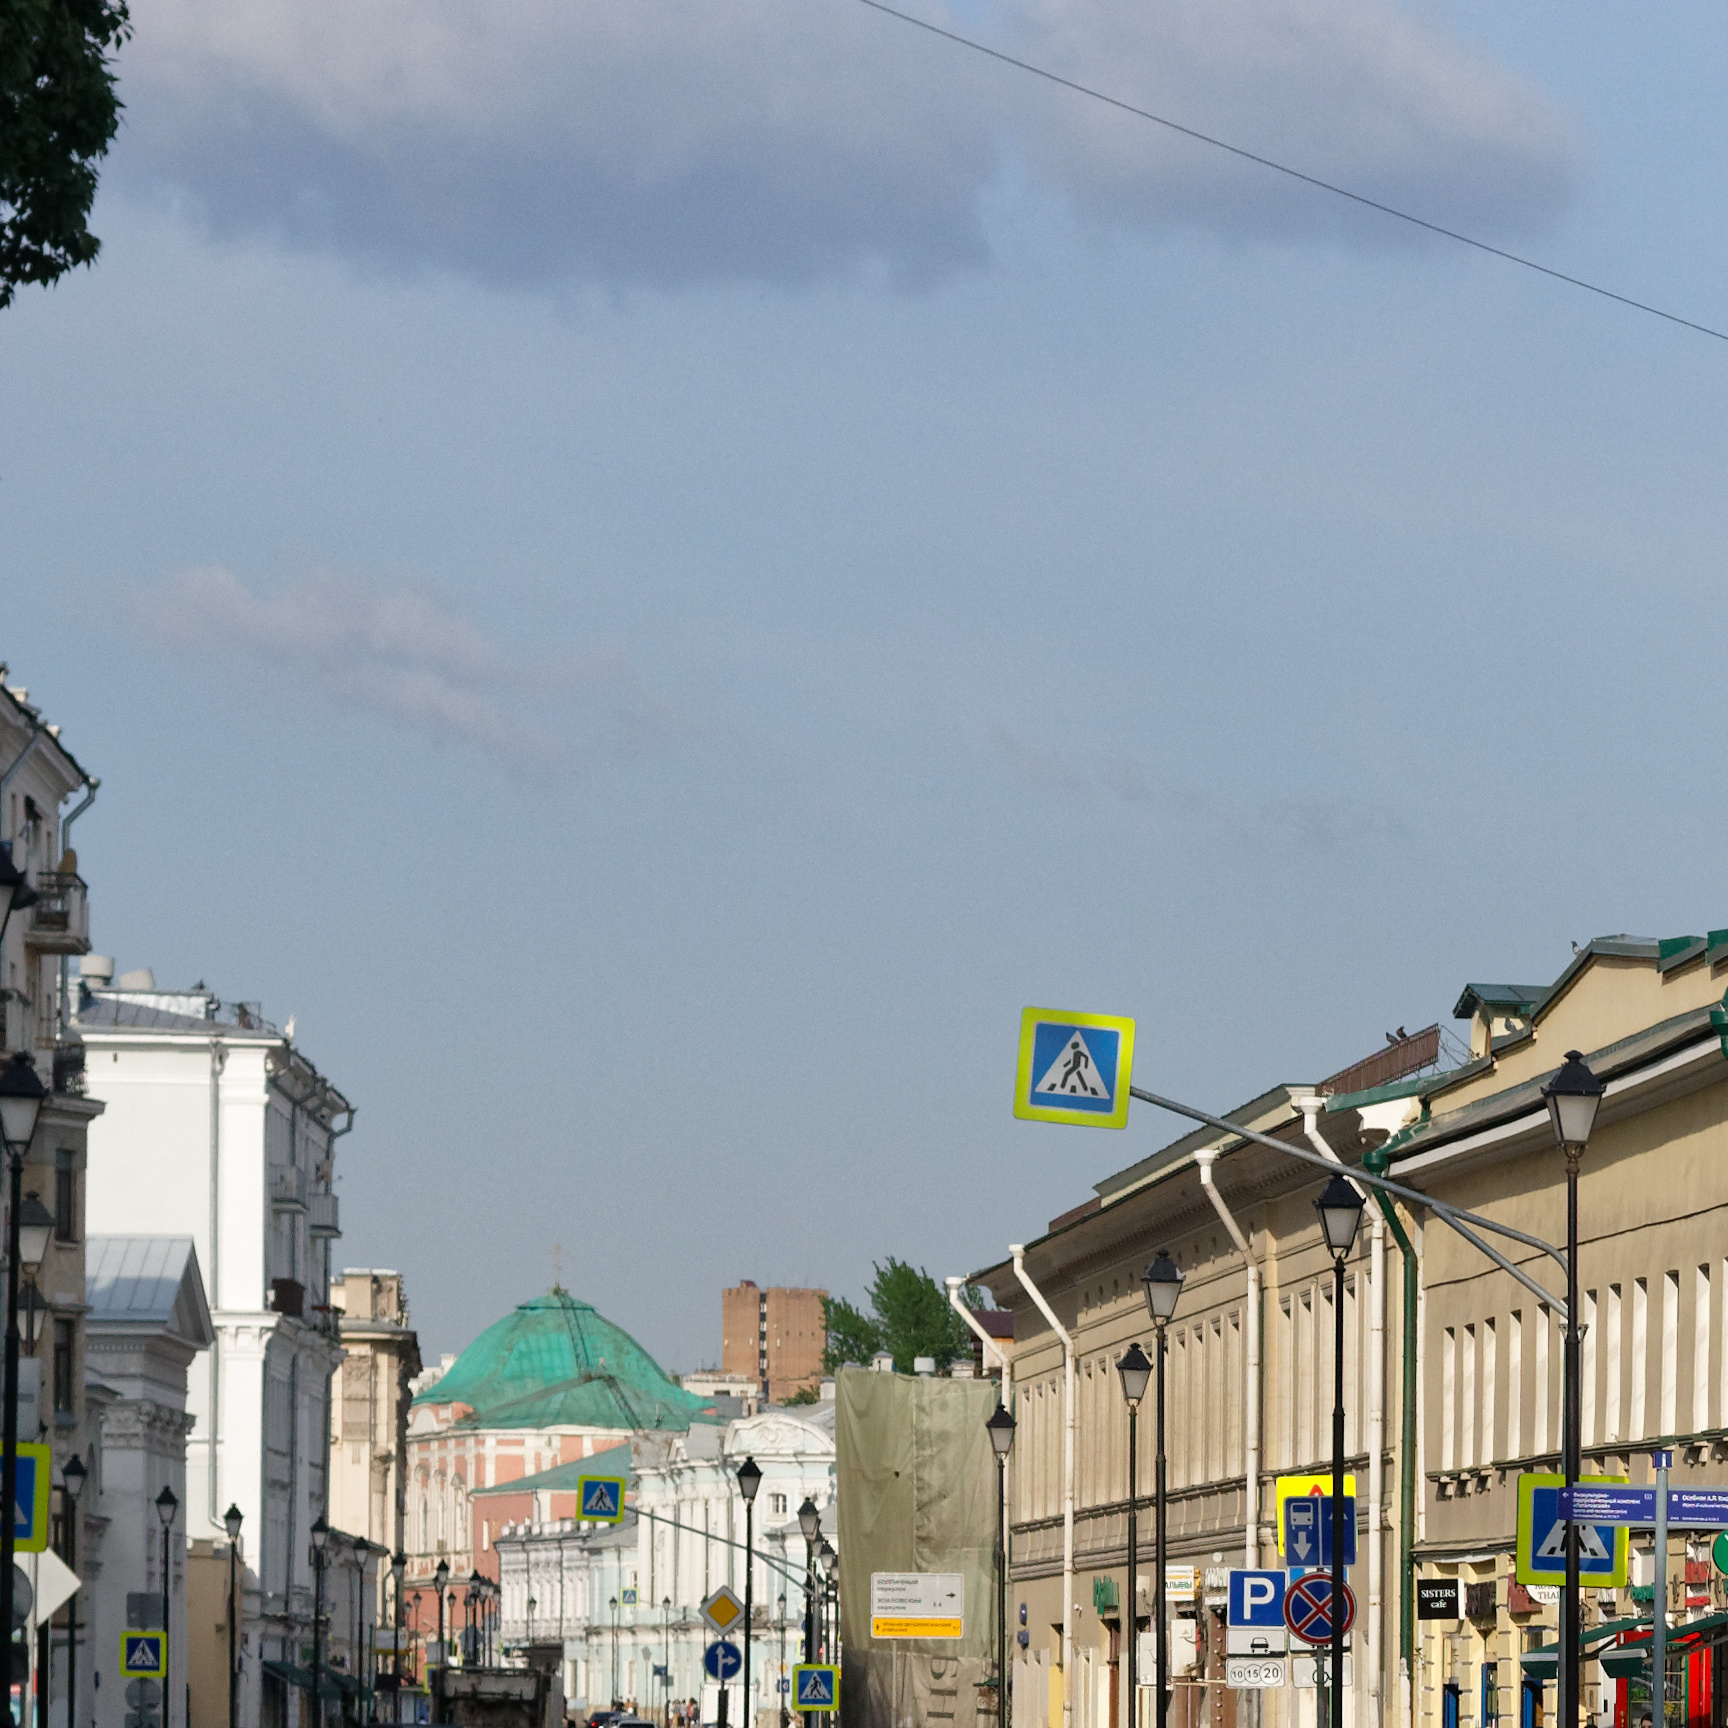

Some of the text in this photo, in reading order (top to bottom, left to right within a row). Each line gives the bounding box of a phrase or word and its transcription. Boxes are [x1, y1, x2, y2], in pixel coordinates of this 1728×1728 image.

[1243, 1577, 1275, 1620] P
[1421, 1589, 1456, 1599] SISTERS
[1430, 1599, 1447, 1608] cafe
[1232, 1668, 1279, 1679] 10 15 20
